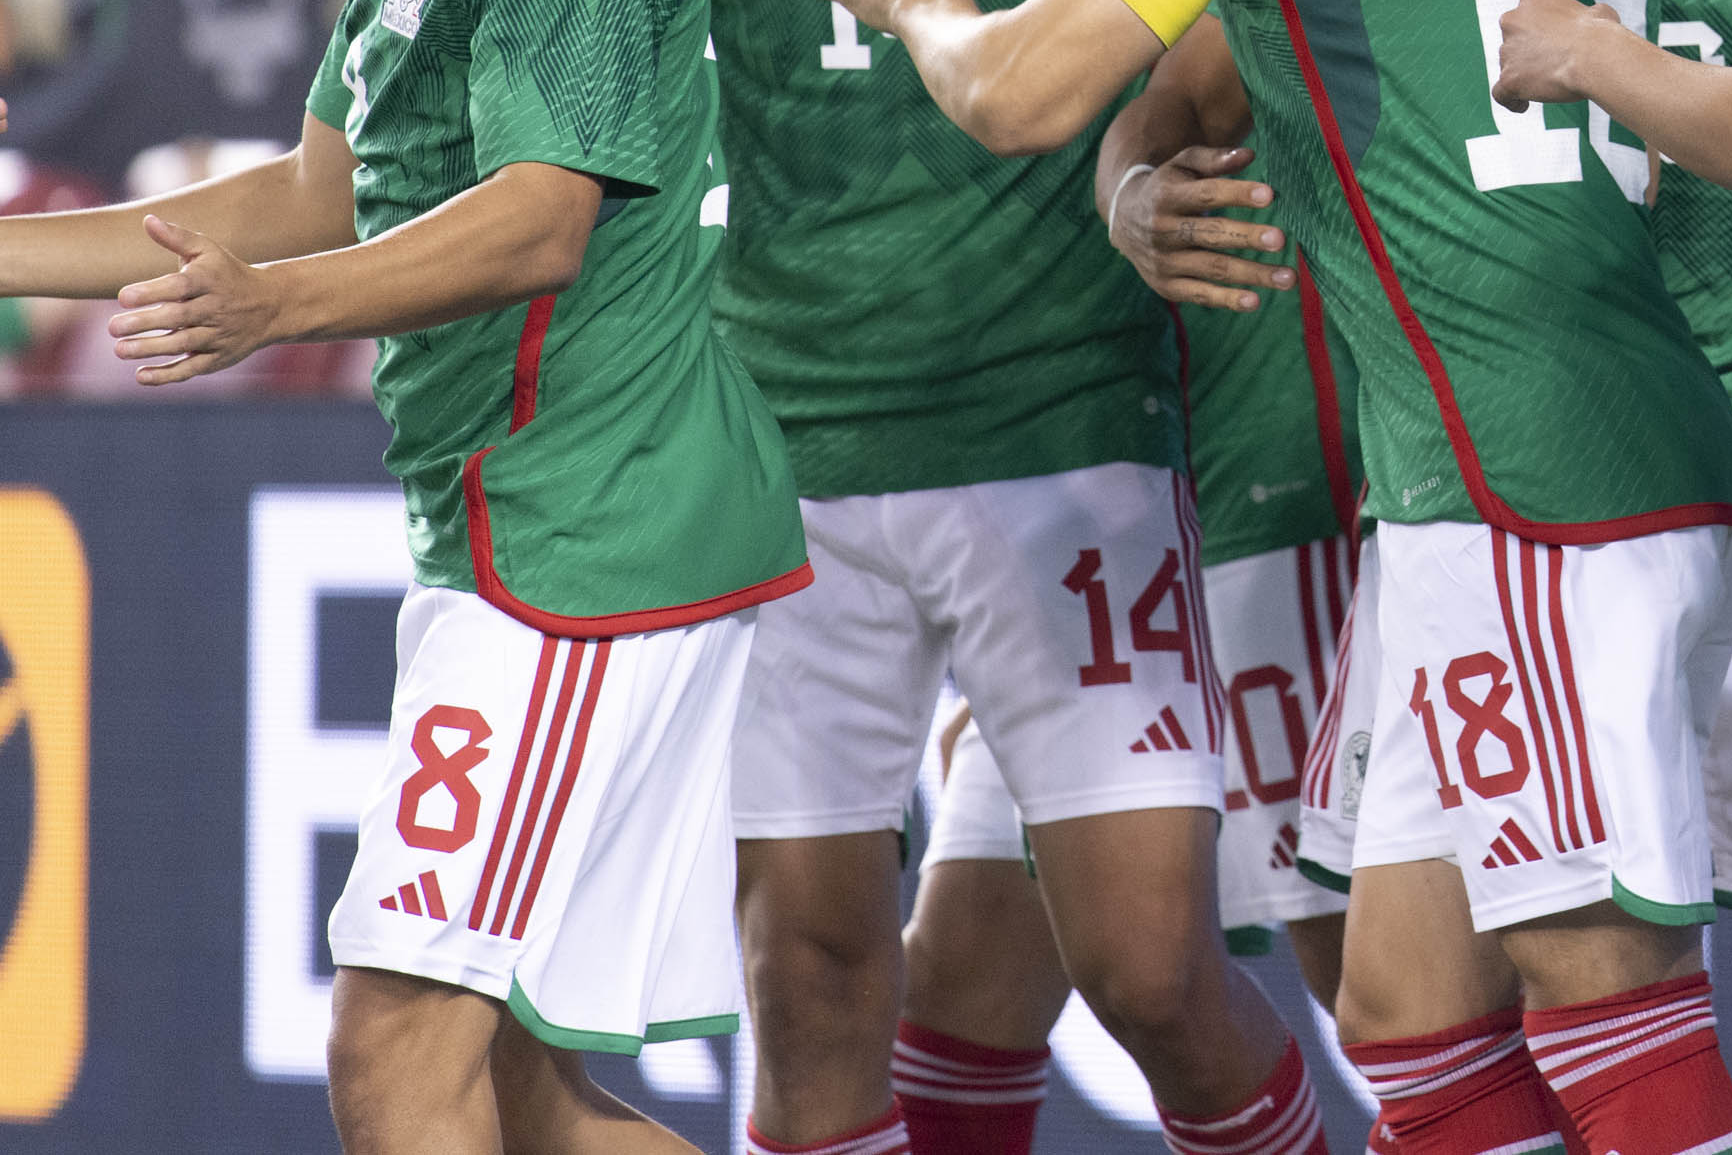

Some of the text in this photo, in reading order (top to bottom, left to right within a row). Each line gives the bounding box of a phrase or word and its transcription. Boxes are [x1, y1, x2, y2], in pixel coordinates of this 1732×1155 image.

[1061, 547, 1197, 687] 14
[396, 703, 493, 854] 8
[1409, 650, 1531, 810] 18
